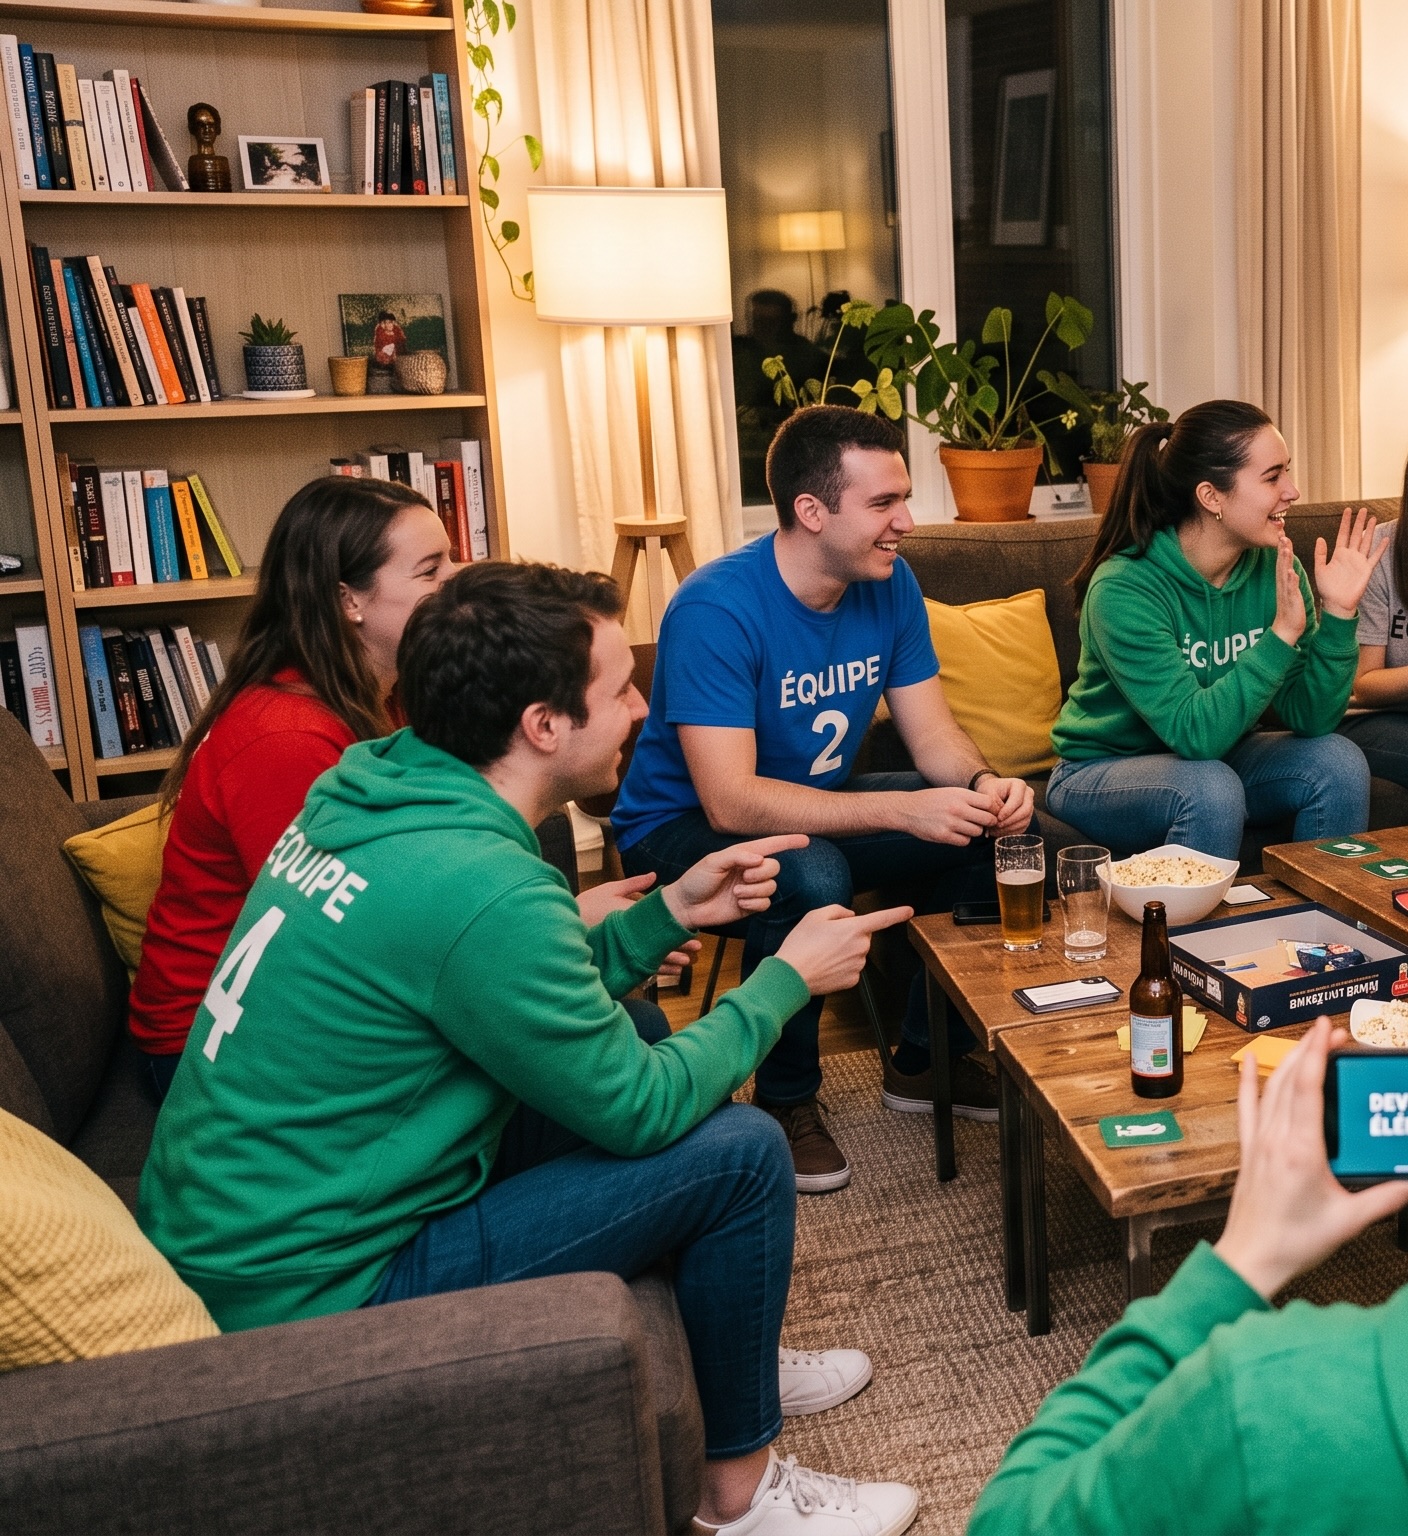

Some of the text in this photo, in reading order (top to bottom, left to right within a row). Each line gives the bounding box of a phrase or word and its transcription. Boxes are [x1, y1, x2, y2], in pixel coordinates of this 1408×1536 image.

[780, 655, 880, 709] ÉQUIPE
[809, 709, 849, 776] 2
[203, 905, 286, 1063] 4
